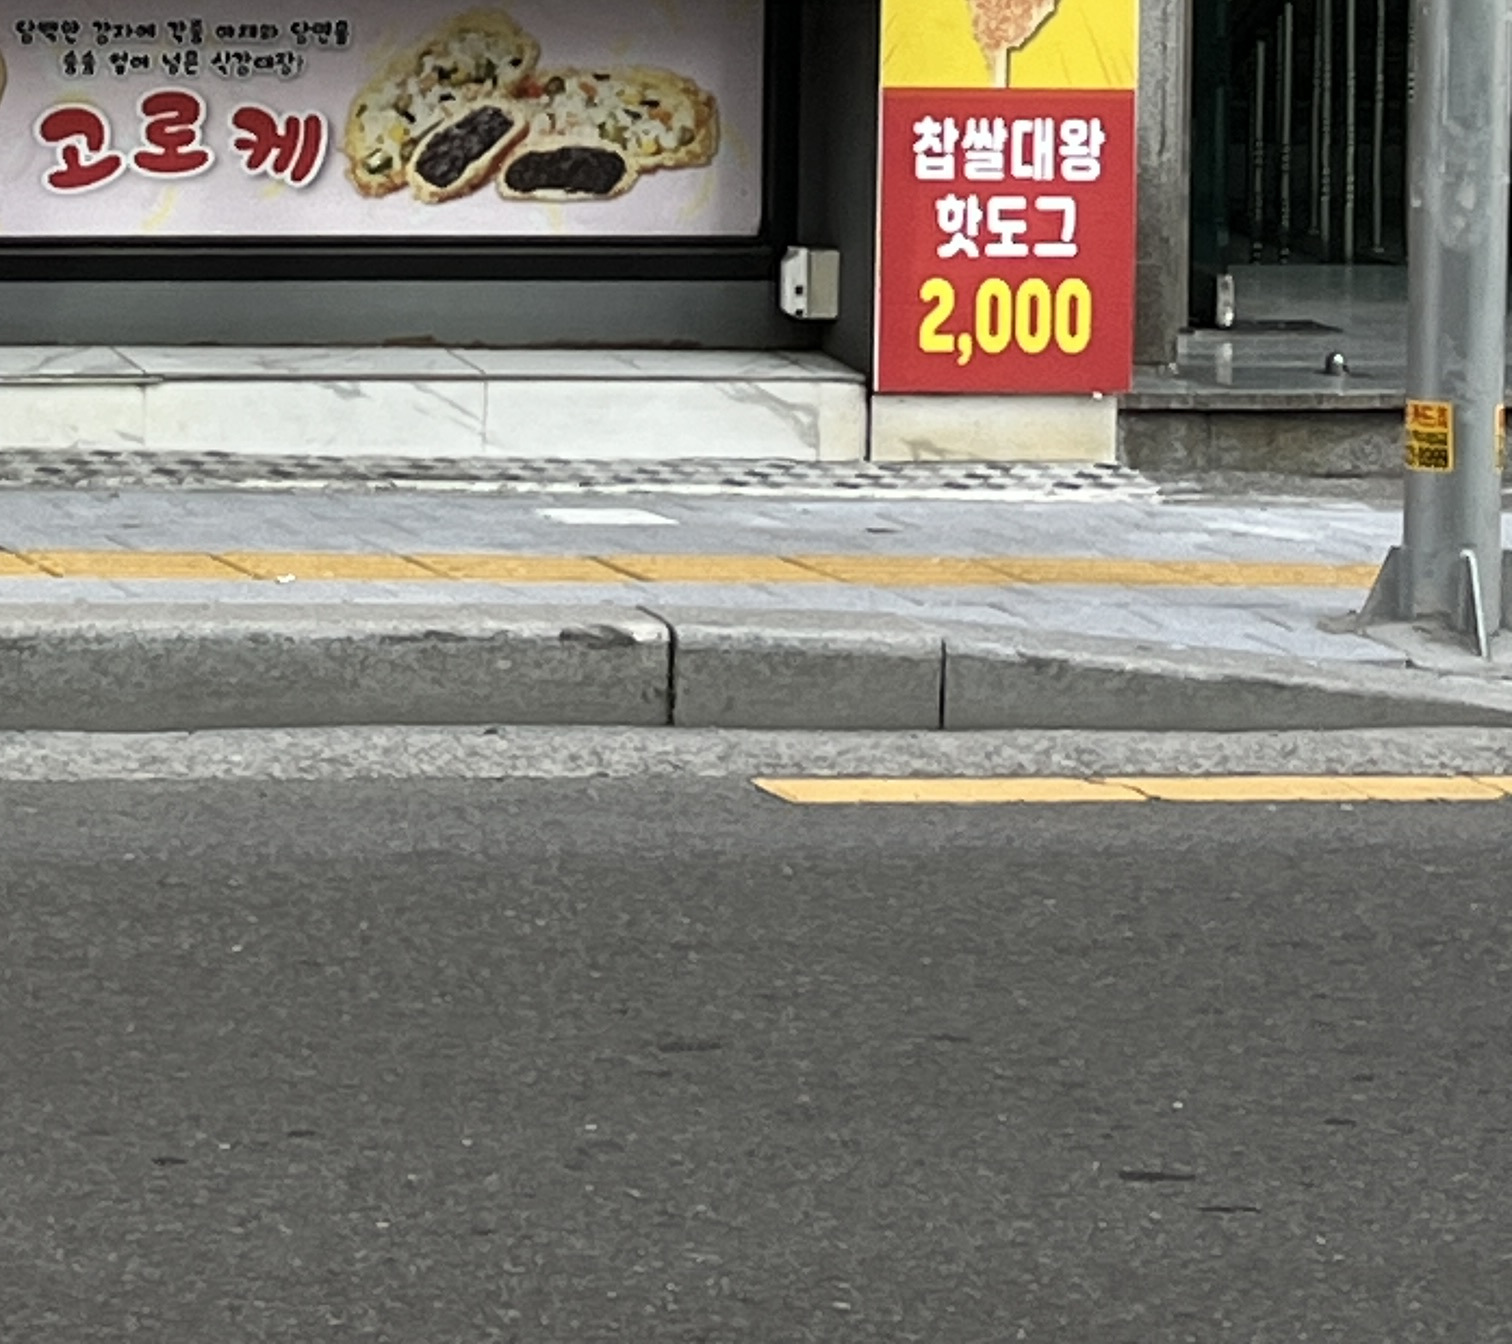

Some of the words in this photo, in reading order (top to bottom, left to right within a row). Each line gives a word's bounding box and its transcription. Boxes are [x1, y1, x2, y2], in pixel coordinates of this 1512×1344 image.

[37, 90, 323, 188] 고로케
[911, 115, 1106, 182] 찹쌀대왕
[934, 193, 1079, 259] 핫도그
[918, 277, 1093, 366] 2,000
